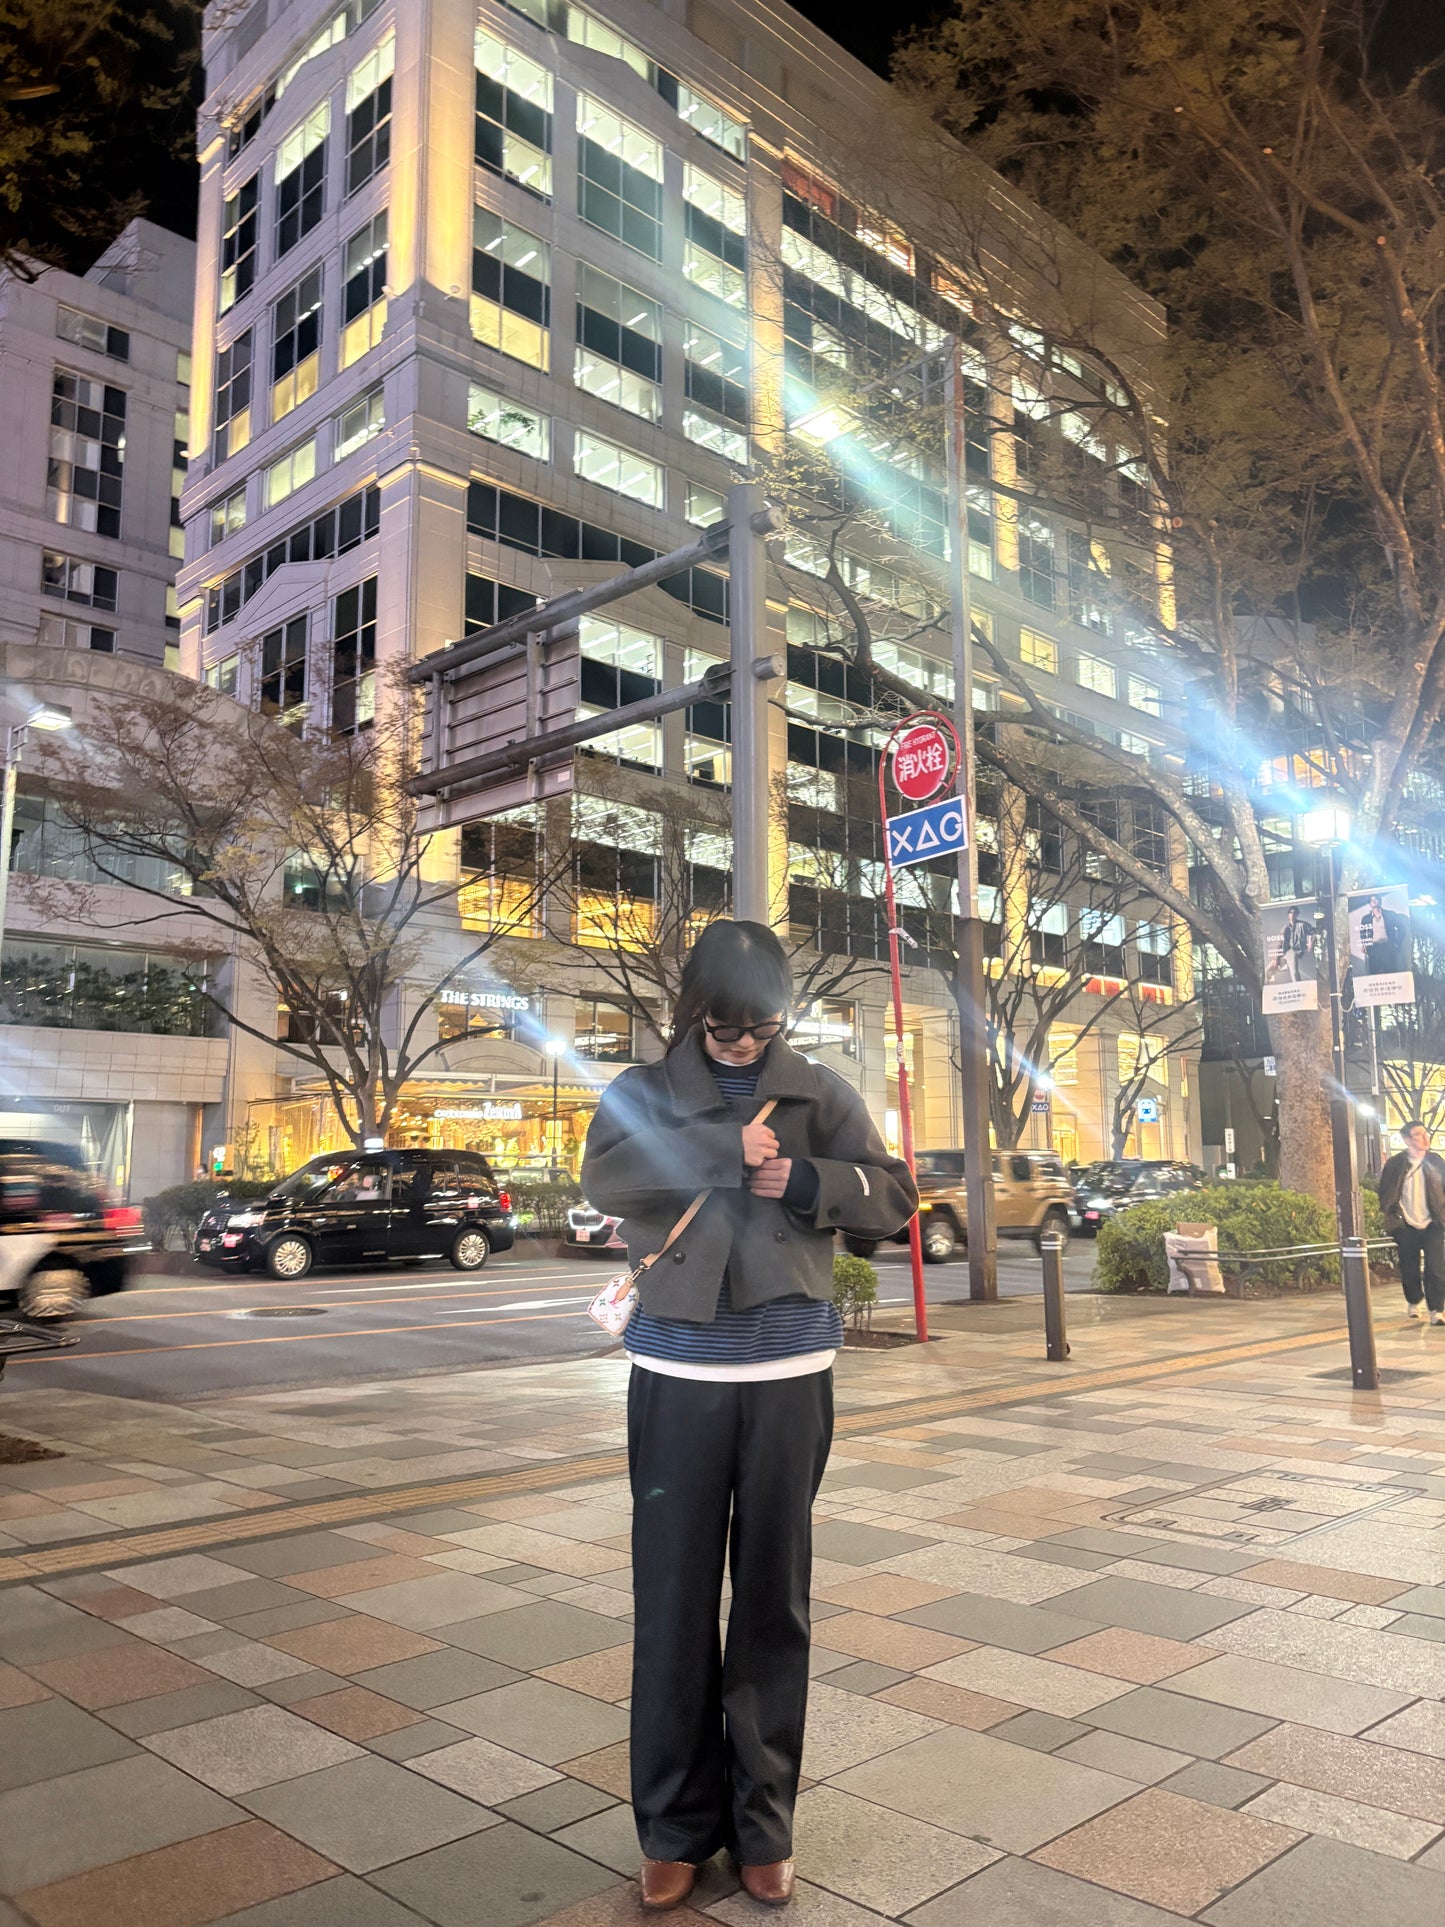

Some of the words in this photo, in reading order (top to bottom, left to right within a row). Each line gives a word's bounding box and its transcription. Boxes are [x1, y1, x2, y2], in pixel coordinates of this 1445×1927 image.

[898, 743, 944, 782] 消火栓
[440, 990, 469, 1005] THE
[471, 993, 529, 1010] STRINGS
[53, 1104, 71, 1112] OUT
